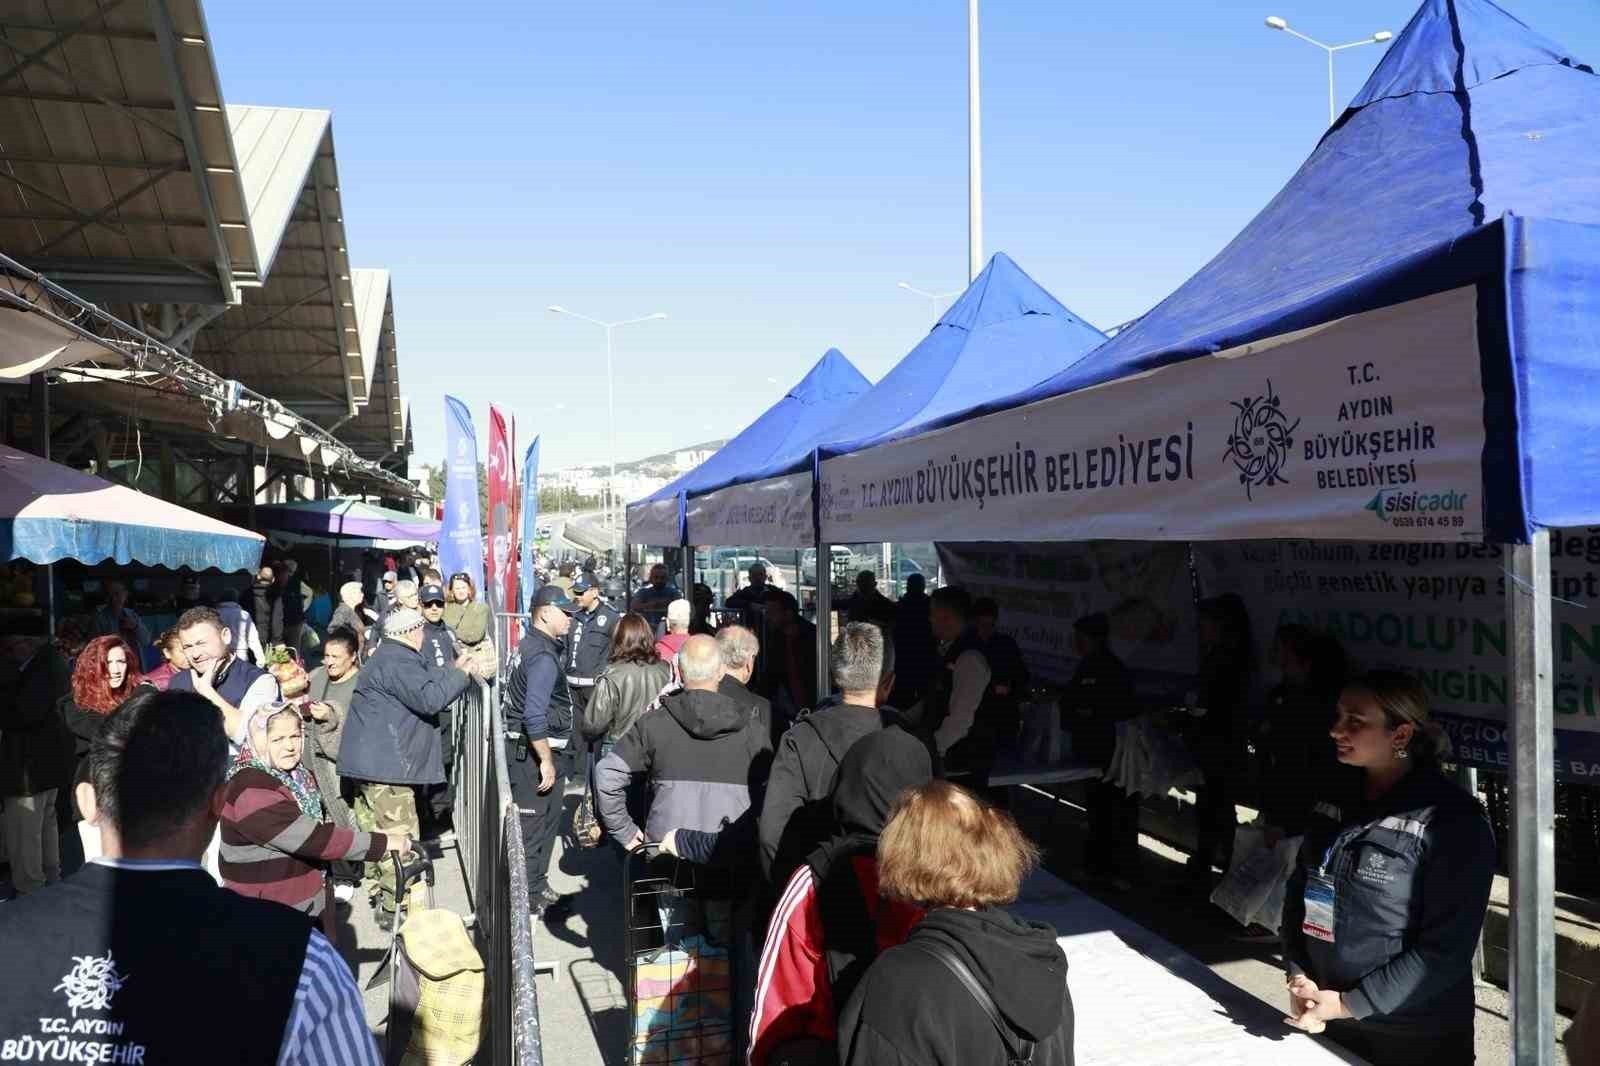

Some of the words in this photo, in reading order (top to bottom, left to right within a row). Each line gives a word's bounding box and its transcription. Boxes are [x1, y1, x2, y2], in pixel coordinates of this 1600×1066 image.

[1347, 362, 1380, 385] T.C.
[1338, 396, 1393, 422] AYDIN
[1304, 421, 1435, 460] BÜYÜKŞEHİR
[861, 482, 878, 508] T.C.
[880, 476, 914, 507] AYDIN
[917, 440, 1037, 510] BÜYÜKŞEHİR
[1045, 421, 1193, 493] BELEDİYESİ
[1317, 459, 1416, 489] BELEDİYESİ
[1548, 528, 1600, 564] değ
[1403, 574, 1486, 601] yapıya
[1569, 759, 1600, 777] BA
[39, 1018, 70, 1033] T.C.
[71, 1019, 124, 1035] AYDIN
[0, 1035, 146, 1066] BÜYÜKŞEHİR
